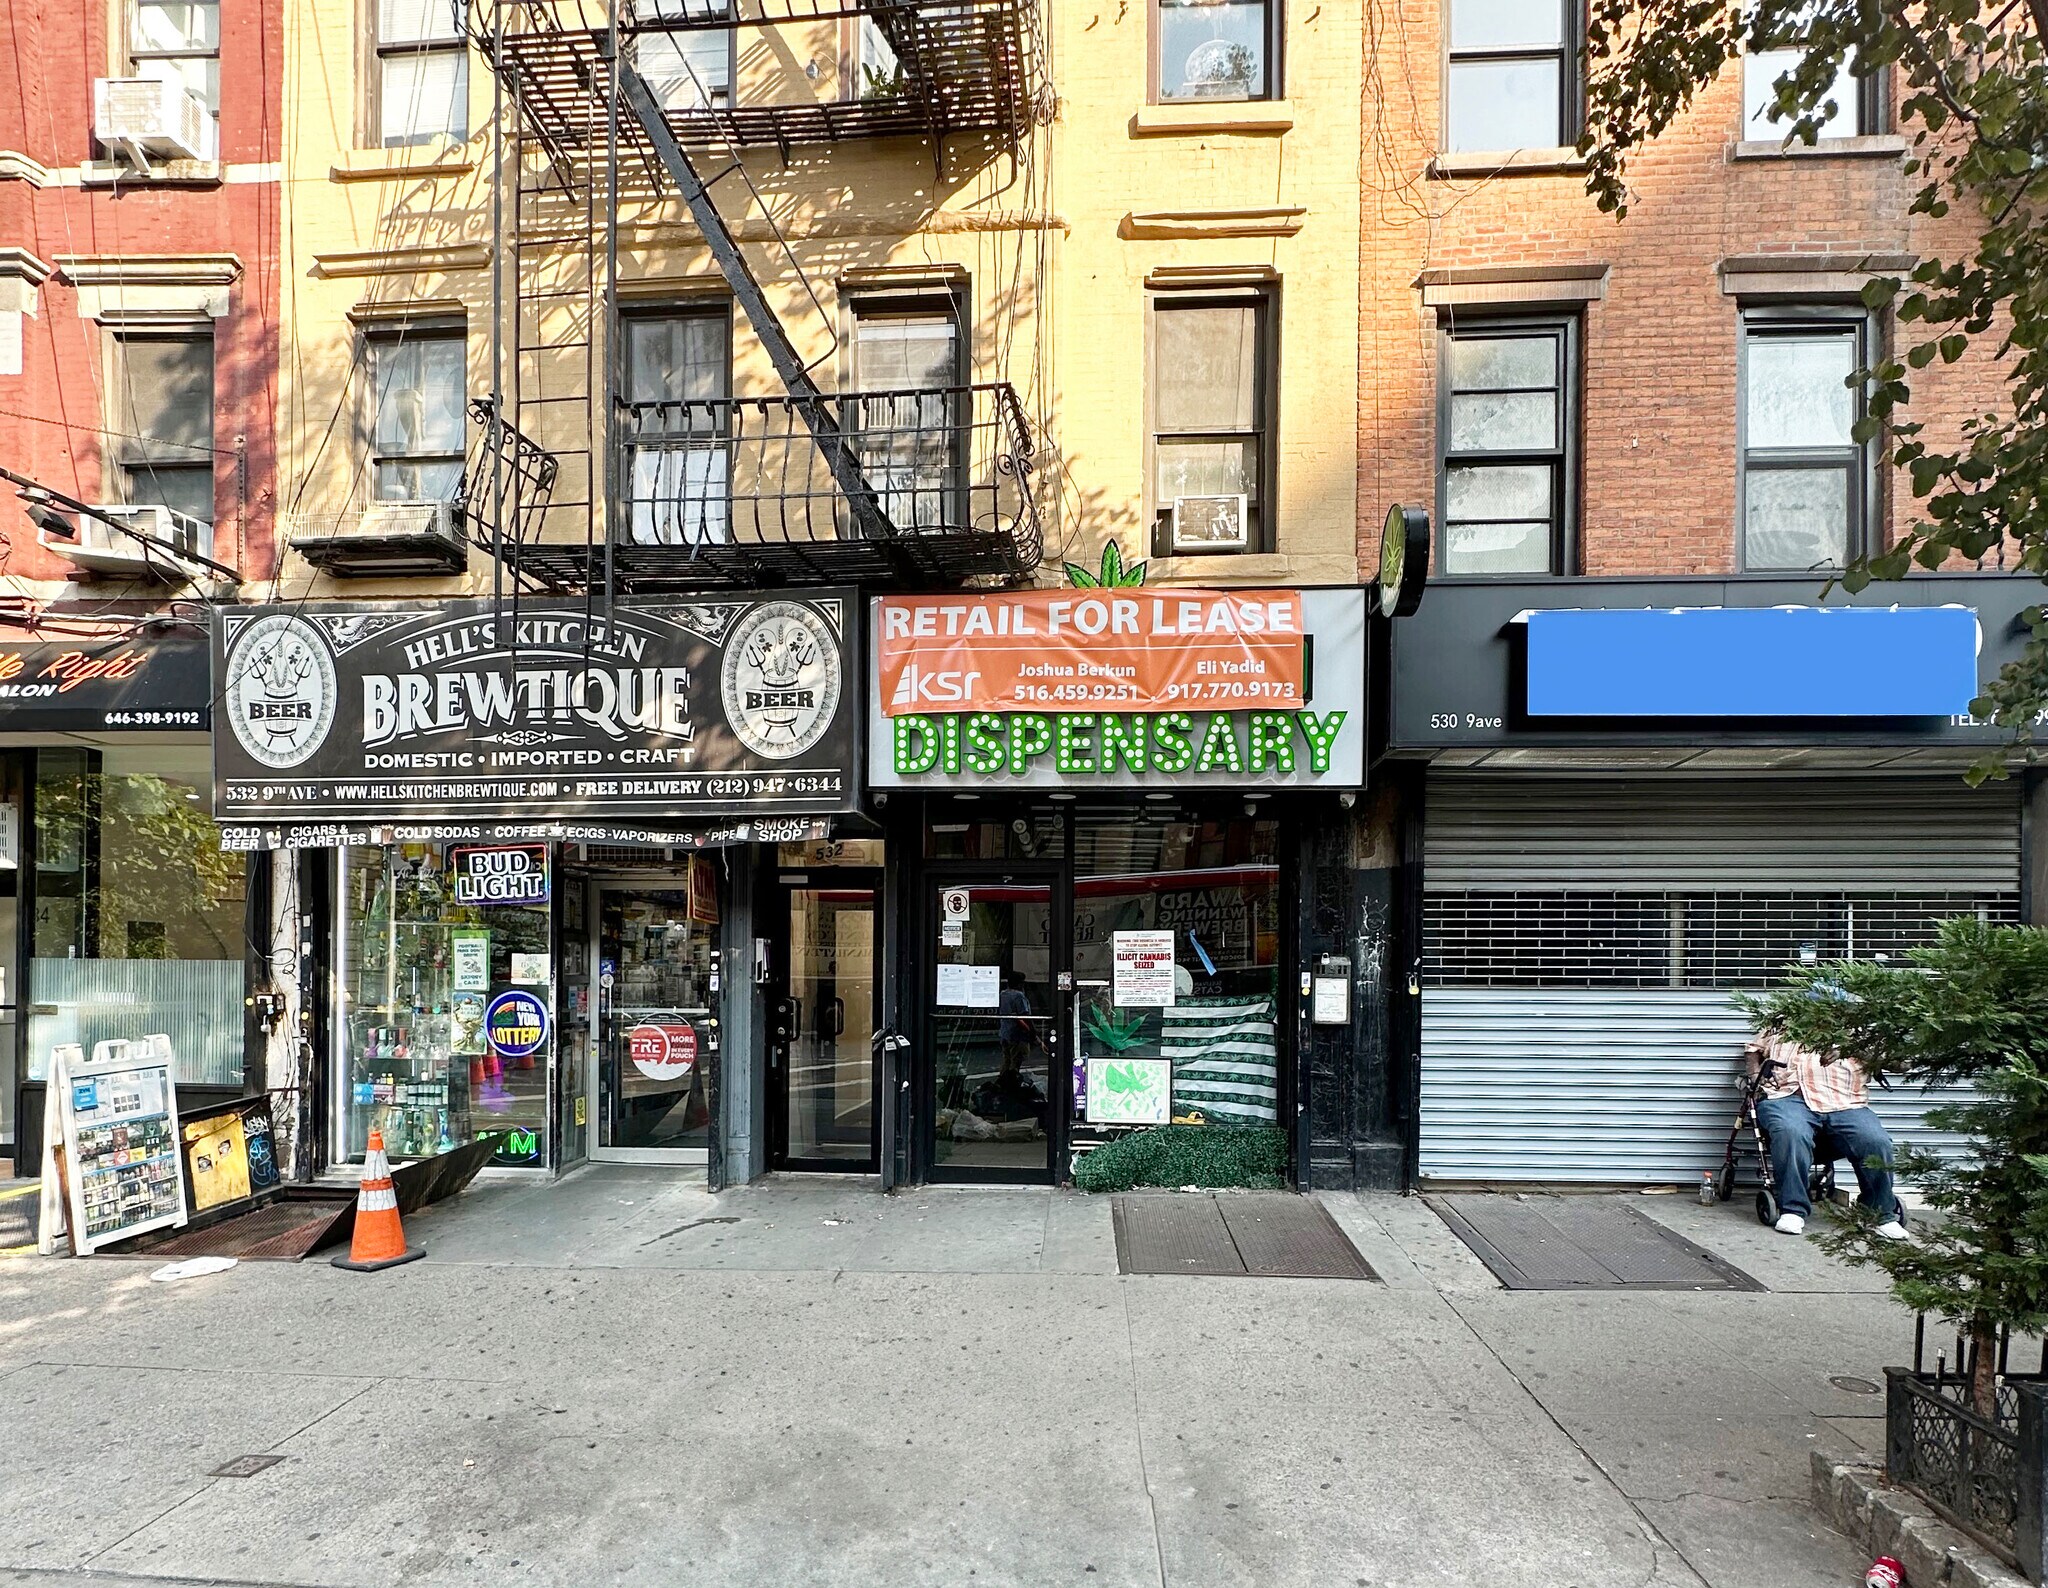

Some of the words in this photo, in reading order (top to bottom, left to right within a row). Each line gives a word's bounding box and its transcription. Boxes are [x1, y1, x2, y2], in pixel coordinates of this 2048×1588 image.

[884, 604, 1036, 640] RETAIL
[1048, 600, 1139, 635] FOR
[1152, 600, 1295, 635] LEASE
[403, 622, 496, 670] HELL'S
[511, 620, 648, 663] KITCHEN
[37, 649, 148, 693] Right
[1018, 662, 1074, 677] Joshua
[1077, 663, 1136, 678] Berkun
[1196, 660, 1217, 675] Eli
[1219, 659, 1266, 675] Yadid
[1014, 683, 1139, 701] 516.459.9251
[1167, 681, 1296, 700] 917.770.9173
[361, 666, 695, 747] BREWTIQUE
[745, 690, 815, 710] BEER
[104, 712, 199, 724] 646-398-9192
[249, 702, 313, 720] BEER
[1430, 713, 1458, 729] 530
[1466, 713, 1502, 728] 9ave
[893, 709, 1348, 774] DISPENSARY
[364, 752, 474, 769] DOMESTIC
[491, 750, 603, 766] IMPORTED
[619, 748, 696, 764] CRAFT
[226, 785, 258, 800] 532
[287, 785, 317, 800] AVE
[334, 781, 558, 800] WWW.HELLSKITCHENBREWTIQUE.COM
[576, 781, 618, 796] FREE
[622, 779, 702, 795] DELIVERY
[706, 778, 750, 798] (212)
[290, 825, 337, 838] CIGARS
[339, 824, 350, 835] &
[753, 817, 810, 831] SMOKE
[222, 827, 261, 839] COLD
[285, 833, 367, 848] CIGARETTES
[394, 827, 432, 840] COLD
[434, 826, 481, 838] SODAS
[494, 826, 546, 838] COFFEE
[758, 829, 803, 842] SHOP
[221, 838, 259, 849] BEER
[816, 842, 844, 860] 532
[468, 850, 530, 877] BUD
[1117, 953, 1138, 961] ILLICIT
[1139, 953, 1171, 961] CANNABIS
[1133, 961, 1155, 969] SEIZED
[517, 1001, 536, 1012] NEW
[518, 1012, 541, 1027] YORK
[492, 1026, 542, 1046] LOTTERY
[631, 1038, 662, 1054] FRE
